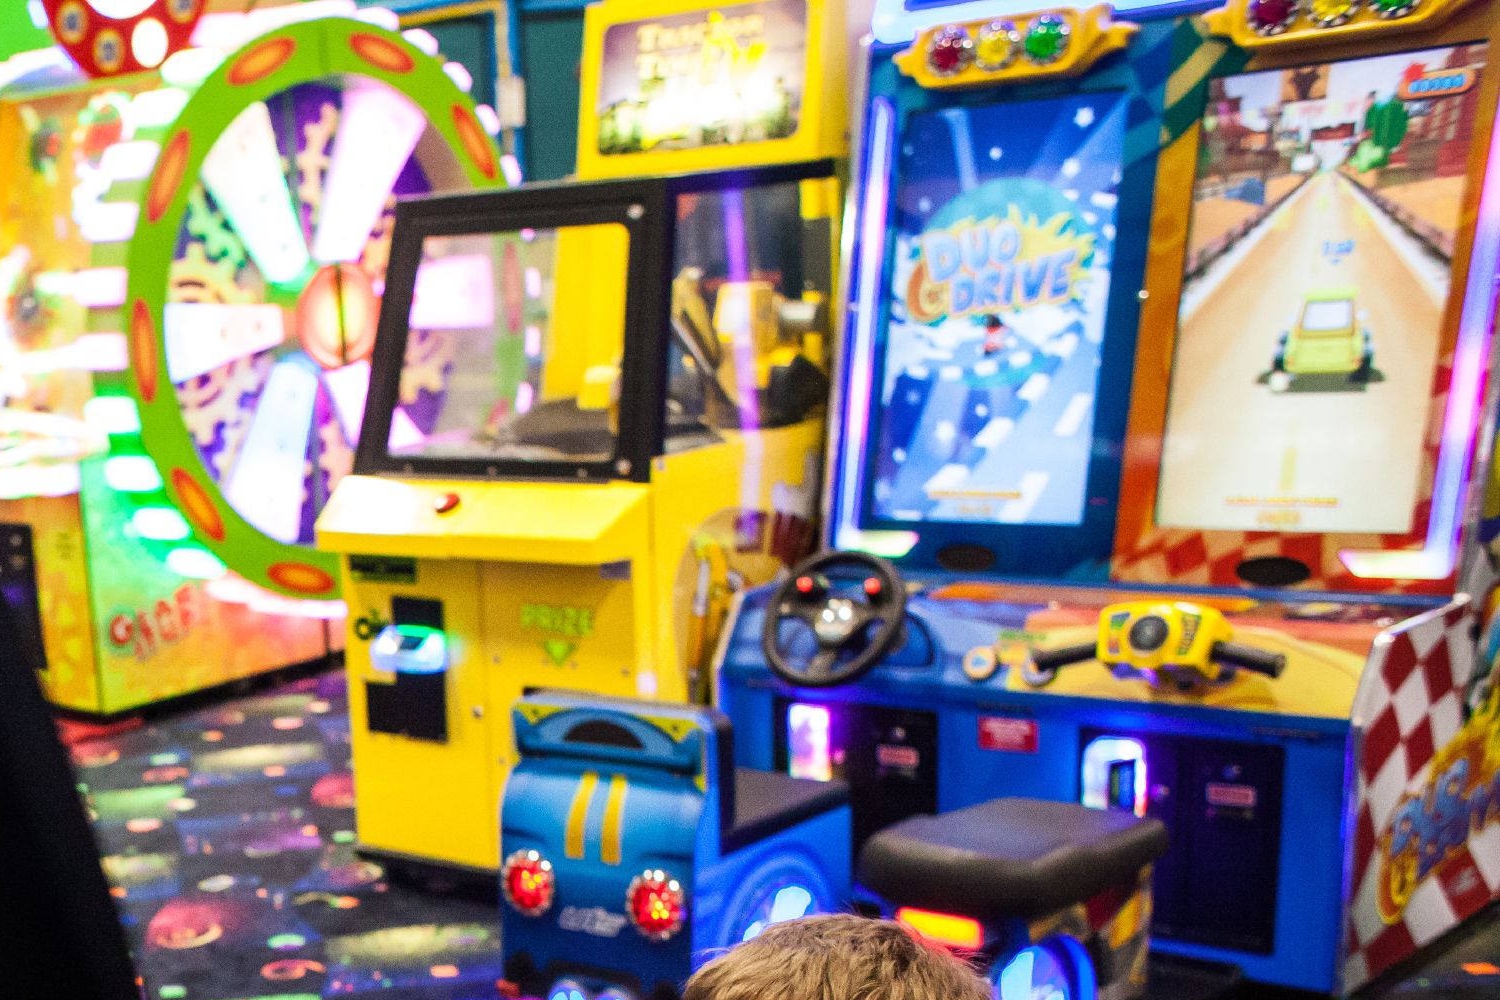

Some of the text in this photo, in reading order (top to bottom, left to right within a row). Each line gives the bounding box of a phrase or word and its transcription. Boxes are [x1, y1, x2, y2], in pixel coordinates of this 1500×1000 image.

[922, 221, 1020, 282] DUO
[949, 249, 1078, 314] DRIVE
[521, 603, 593, 636] PRIZE
